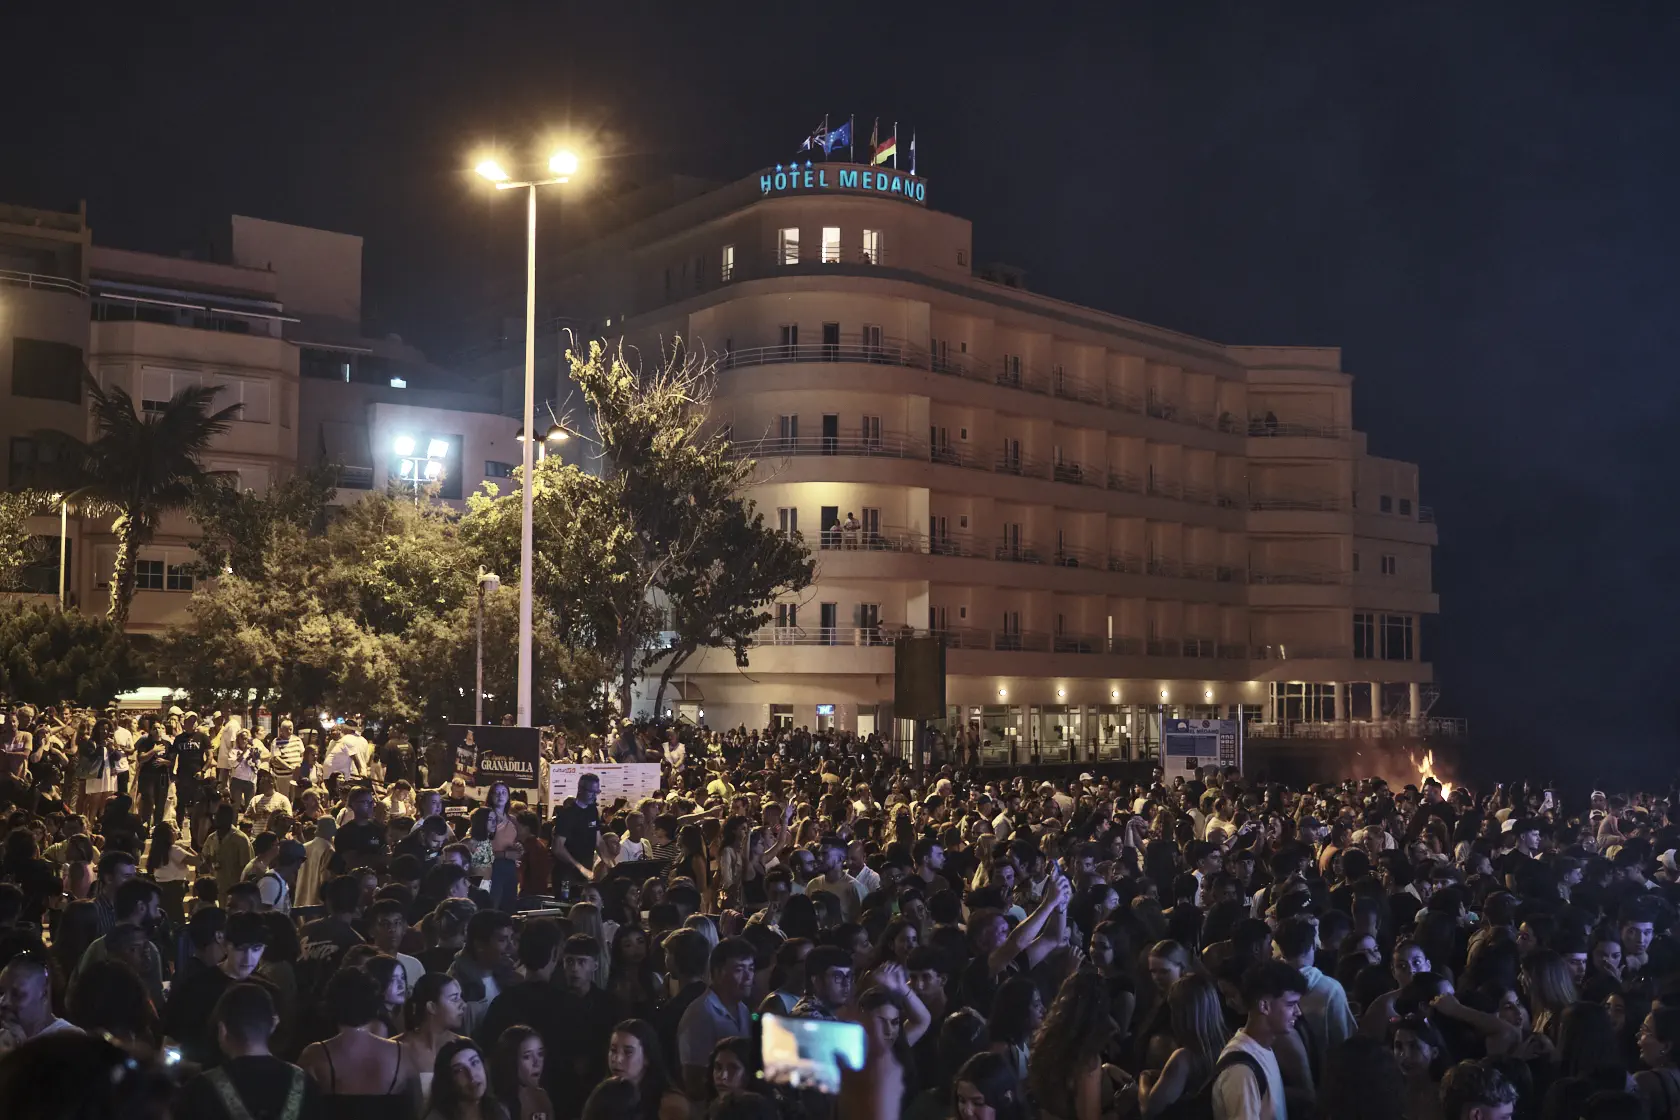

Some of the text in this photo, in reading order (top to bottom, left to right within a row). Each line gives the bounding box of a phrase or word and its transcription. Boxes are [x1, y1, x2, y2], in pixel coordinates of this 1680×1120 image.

[760, 169, 925, 201] HOTEL MEDANO
[481, 759, 534, 773] GRANADILLA
